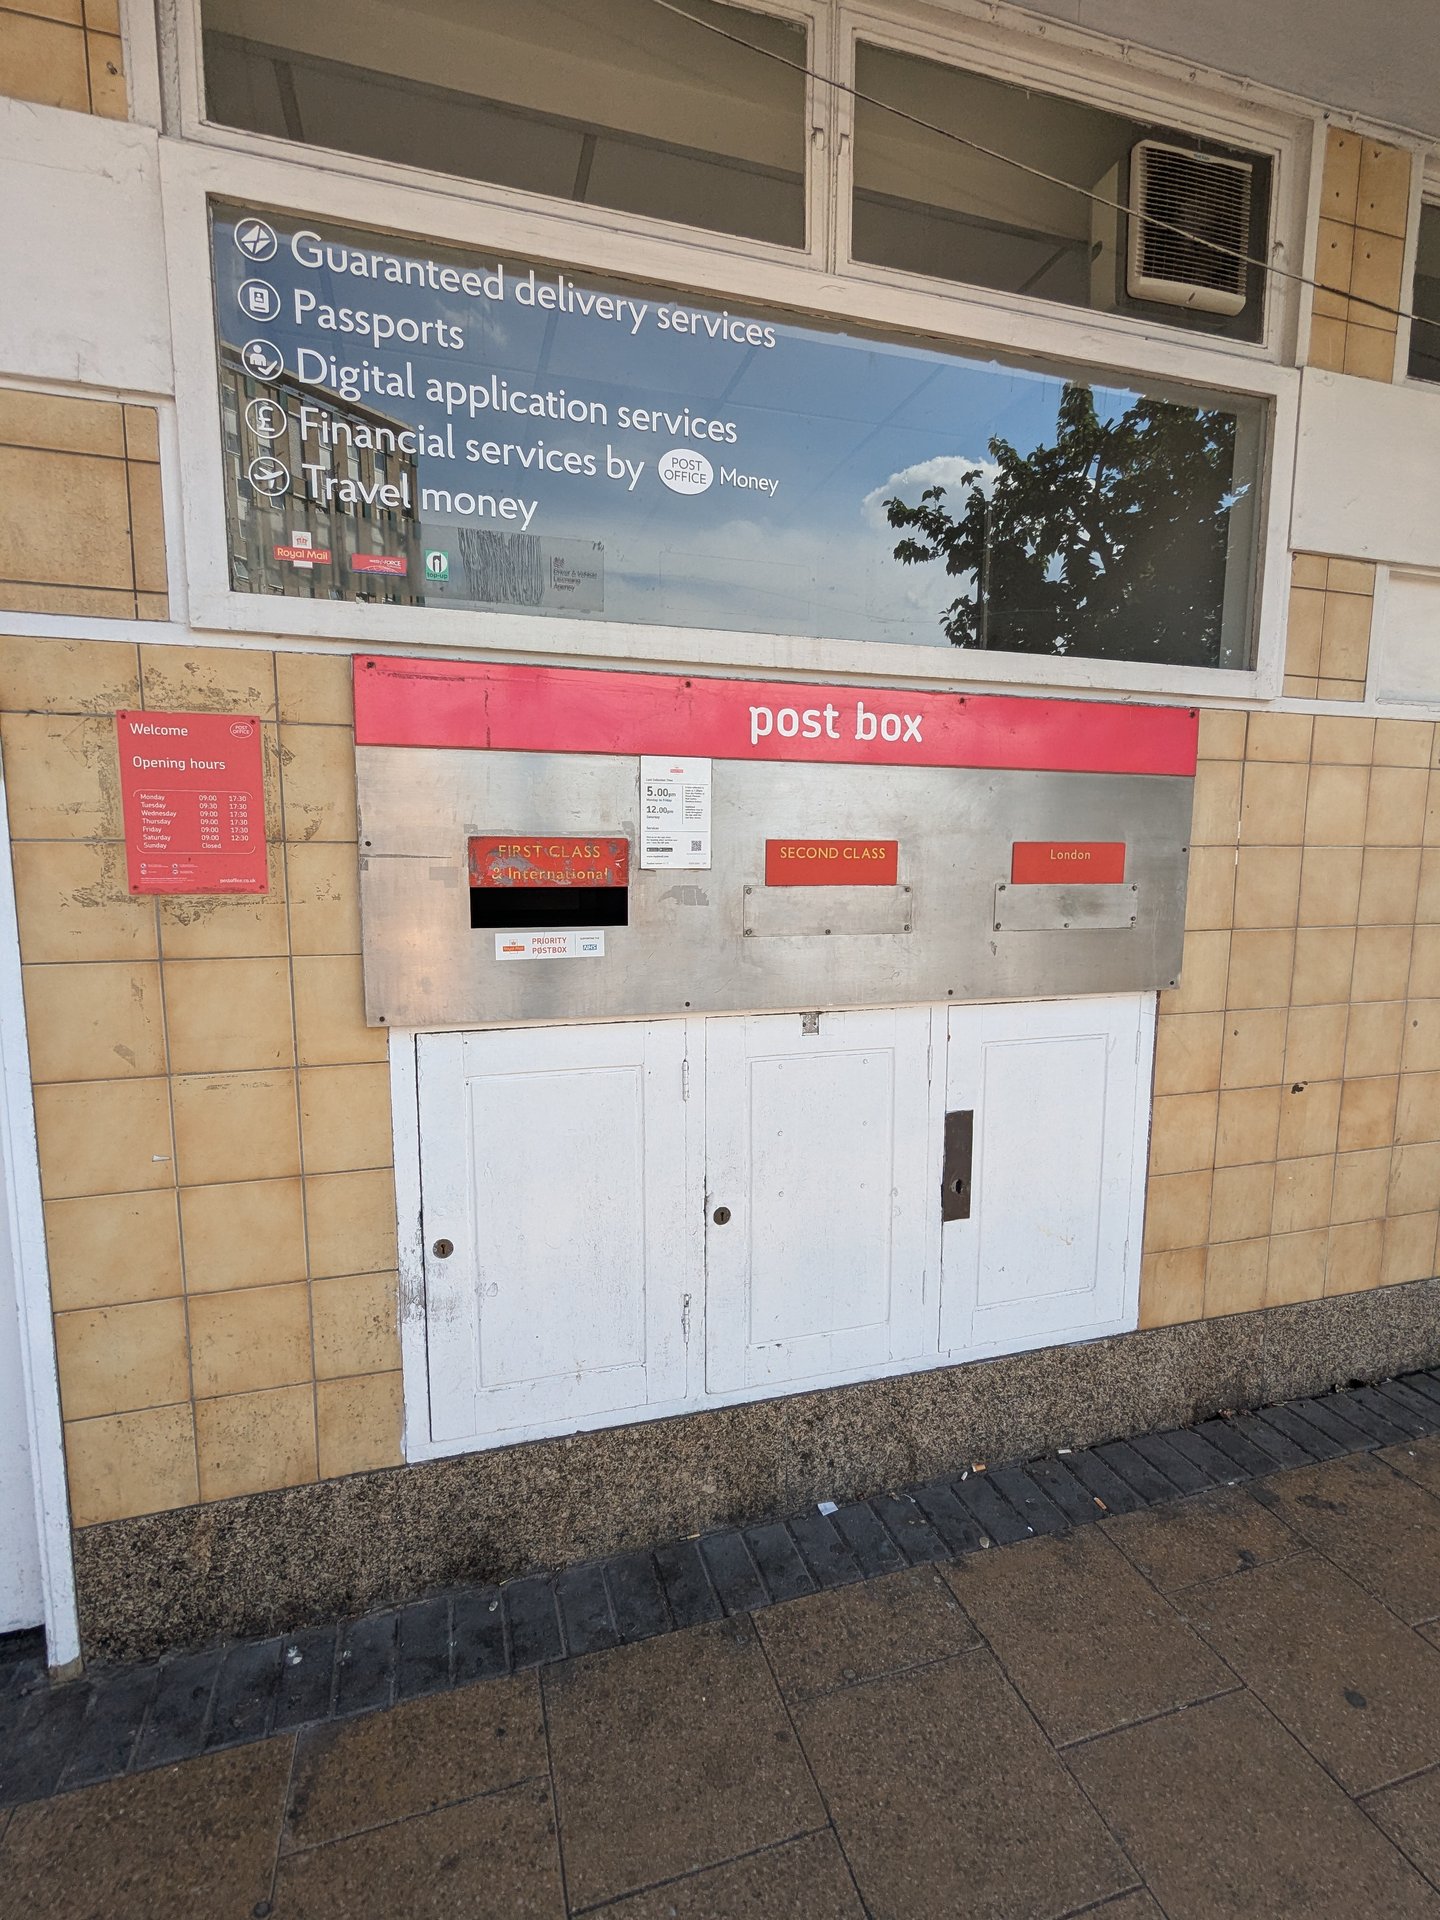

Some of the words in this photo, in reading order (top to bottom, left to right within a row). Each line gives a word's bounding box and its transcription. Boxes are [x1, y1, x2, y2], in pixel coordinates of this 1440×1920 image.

[291, 231, 504, 300] Guaranteed
[515, 269, 647, 334] delivery
[657, 303, 776, 348] services
[293, 289, 464, 349] Passports
[297, 347, 413, 400] Digital
[426, 375, 607, 425] application
[617, 400, 738, 443] services
[300, 407, 454, 459] Financial
[465, 435, 596, 476] services
[606, 444, 645, 490] by
[671, 457, 702, 471] POST
[664, 469, 707, 484] OFFICE
[720, 466, 779, 497] Money
[302, 463, 410, 509] Travel
[421, 484, 538, 531] money
[277, 547, 304, 559] Royal
[307, 550, 328, 560] Mail
[427, 572, 448, 580] top-up
[129, 723, 189, 736] Welcome
[749, 702, 840, 745] post
[855, 701, 924, 743] box
[132, 755, 186, 771] Opening
[190, 758, 226, 770] hours
[499, 845, 542, 858] FIRST
[549, 846, 601, 858] CLASS
[780, 846, 839, 859] SECOND
[843, 846, 886, 860] CLASS
[1050, 848, 1091, 861] London
[491, 867, 502, 880] &
[508, 867, 609, 880] International
